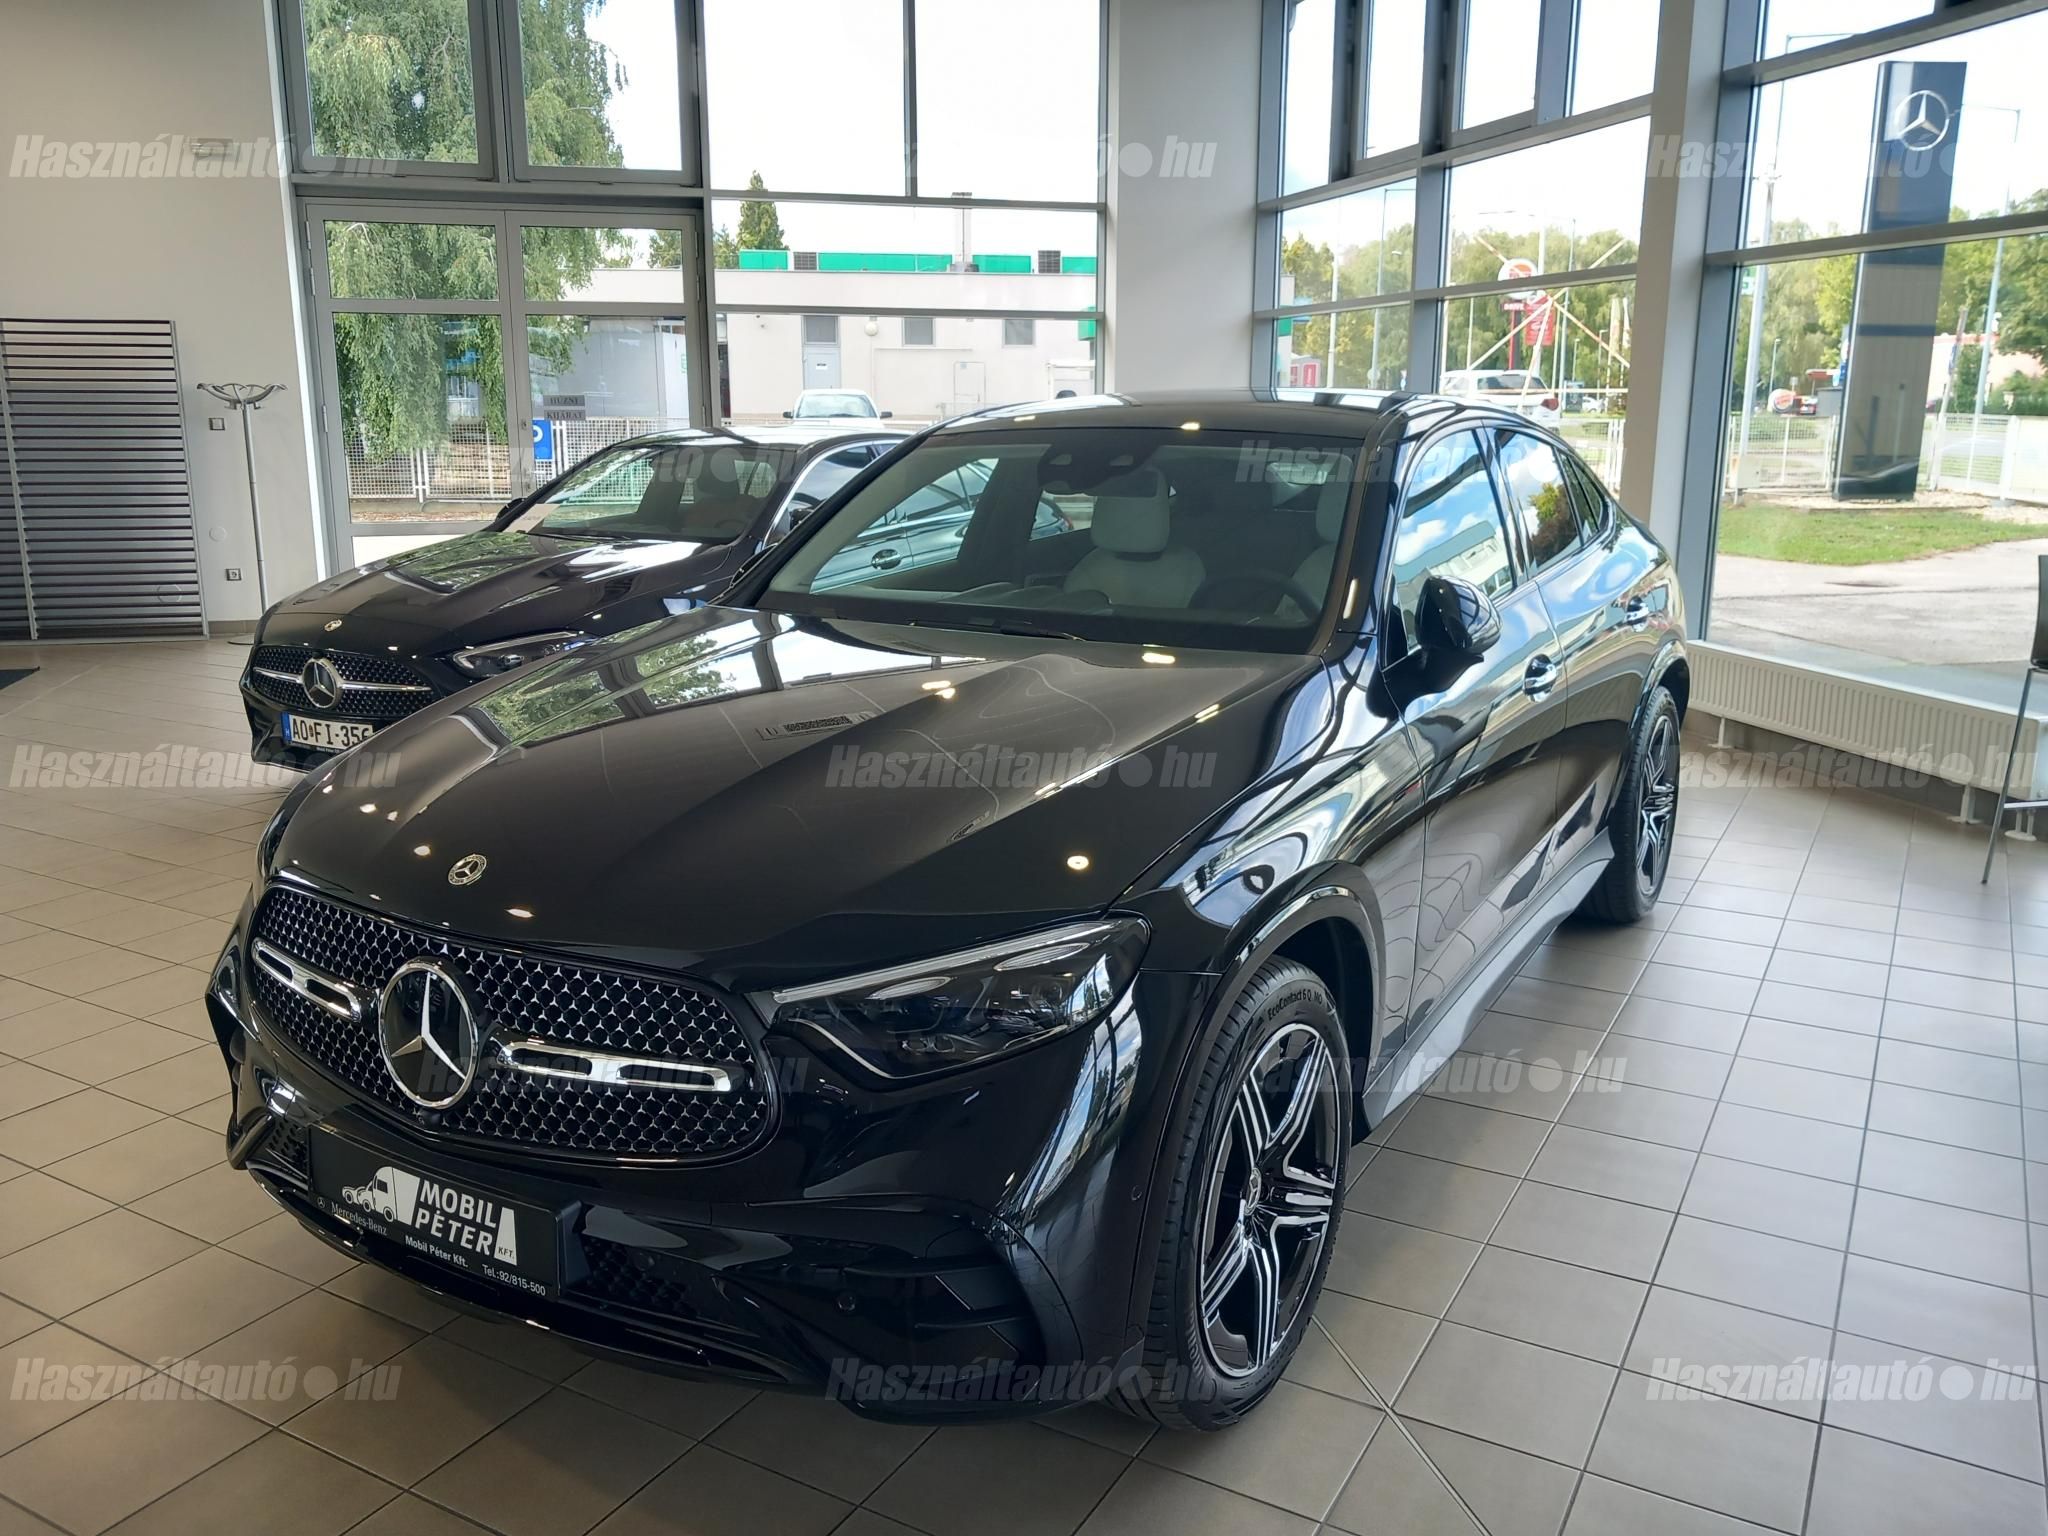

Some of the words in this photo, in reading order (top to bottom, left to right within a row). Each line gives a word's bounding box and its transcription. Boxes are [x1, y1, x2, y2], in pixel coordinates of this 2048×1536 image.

[331, 1201, 388, 1237] Mercedes-Benz
[419, 1179, 497, 1229] MOBIL
[405, 1234, 428, 1254] Mobil
[429, 1244, 452, 1262] Péter
[452, 1253, 469, 1269] Kft.
[415, 1207, 493, 1257] PÉTER
